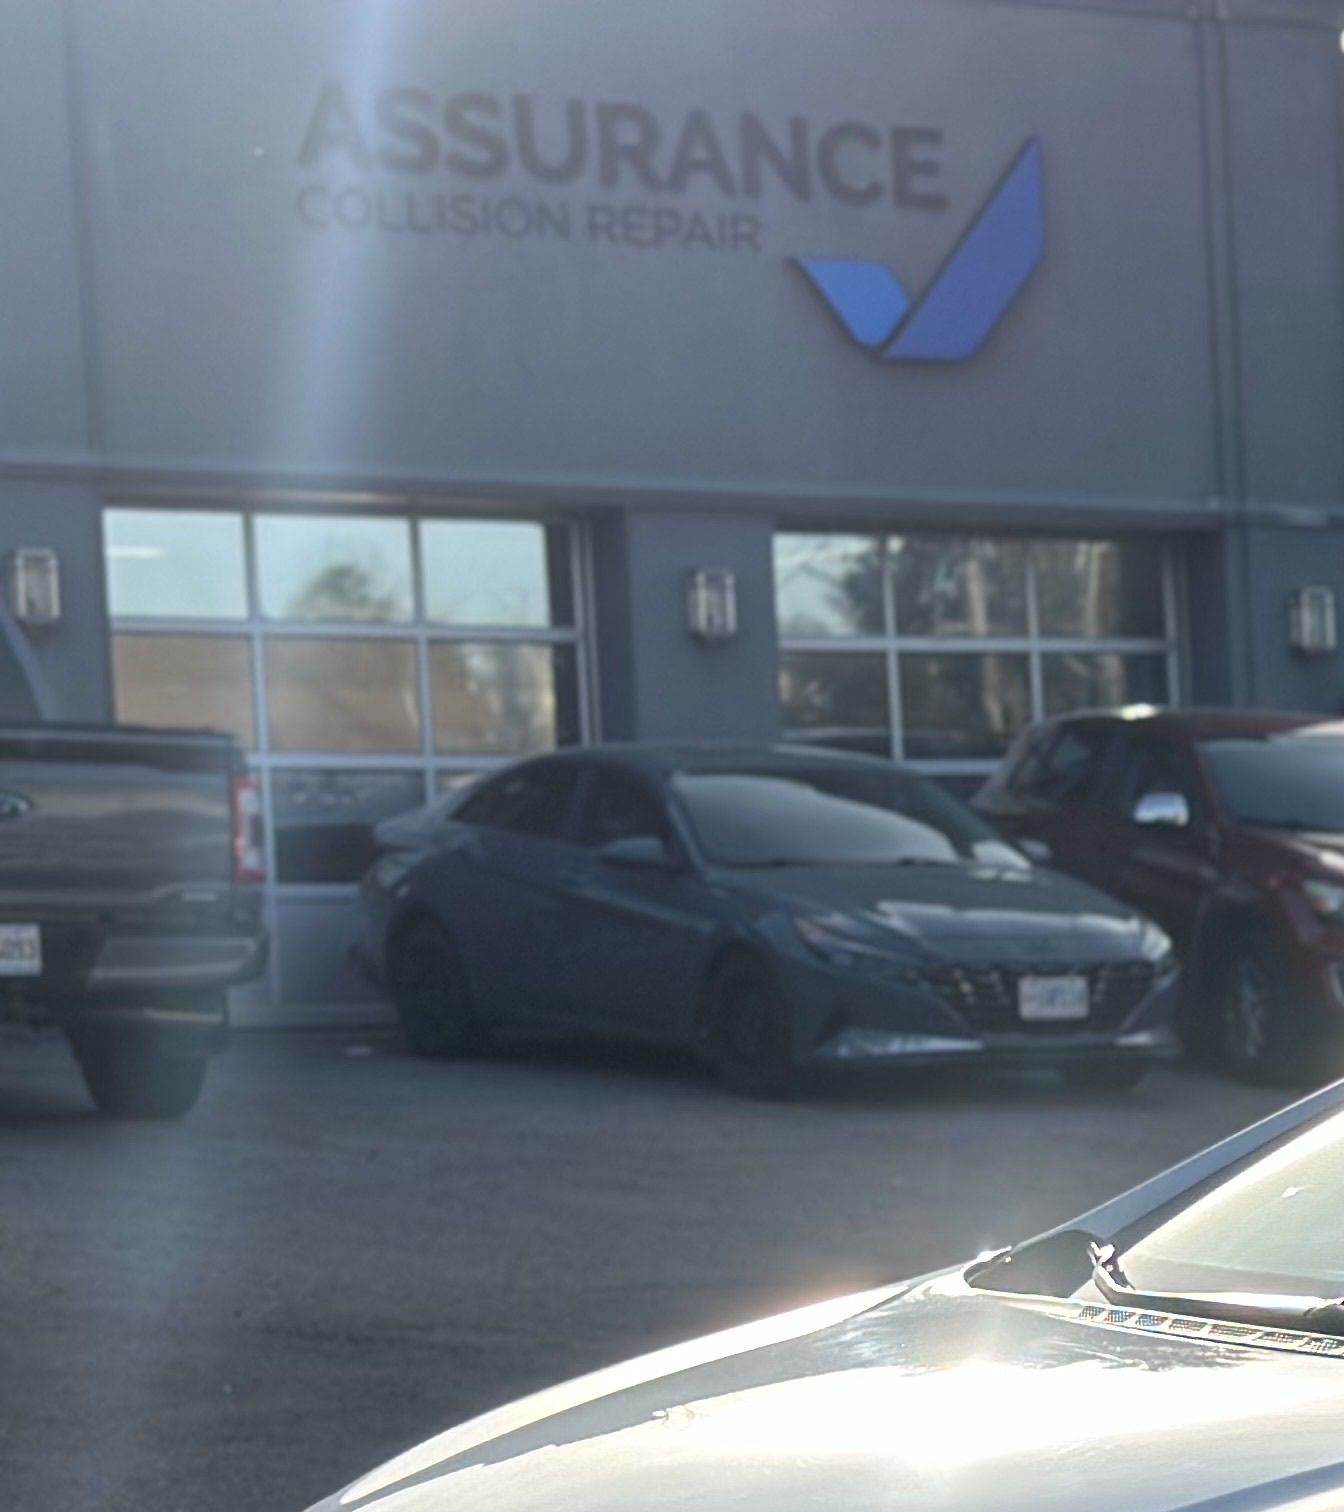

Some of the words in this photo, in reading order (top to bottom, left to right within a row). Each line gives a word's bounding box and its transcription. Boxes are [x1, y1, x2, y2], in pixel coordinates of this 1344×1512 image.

[296, 79, 948, 213] ASSURANCE
[296, 184, 571, 242] COLLISION
[587, 204, 763, 254] REPAIR
